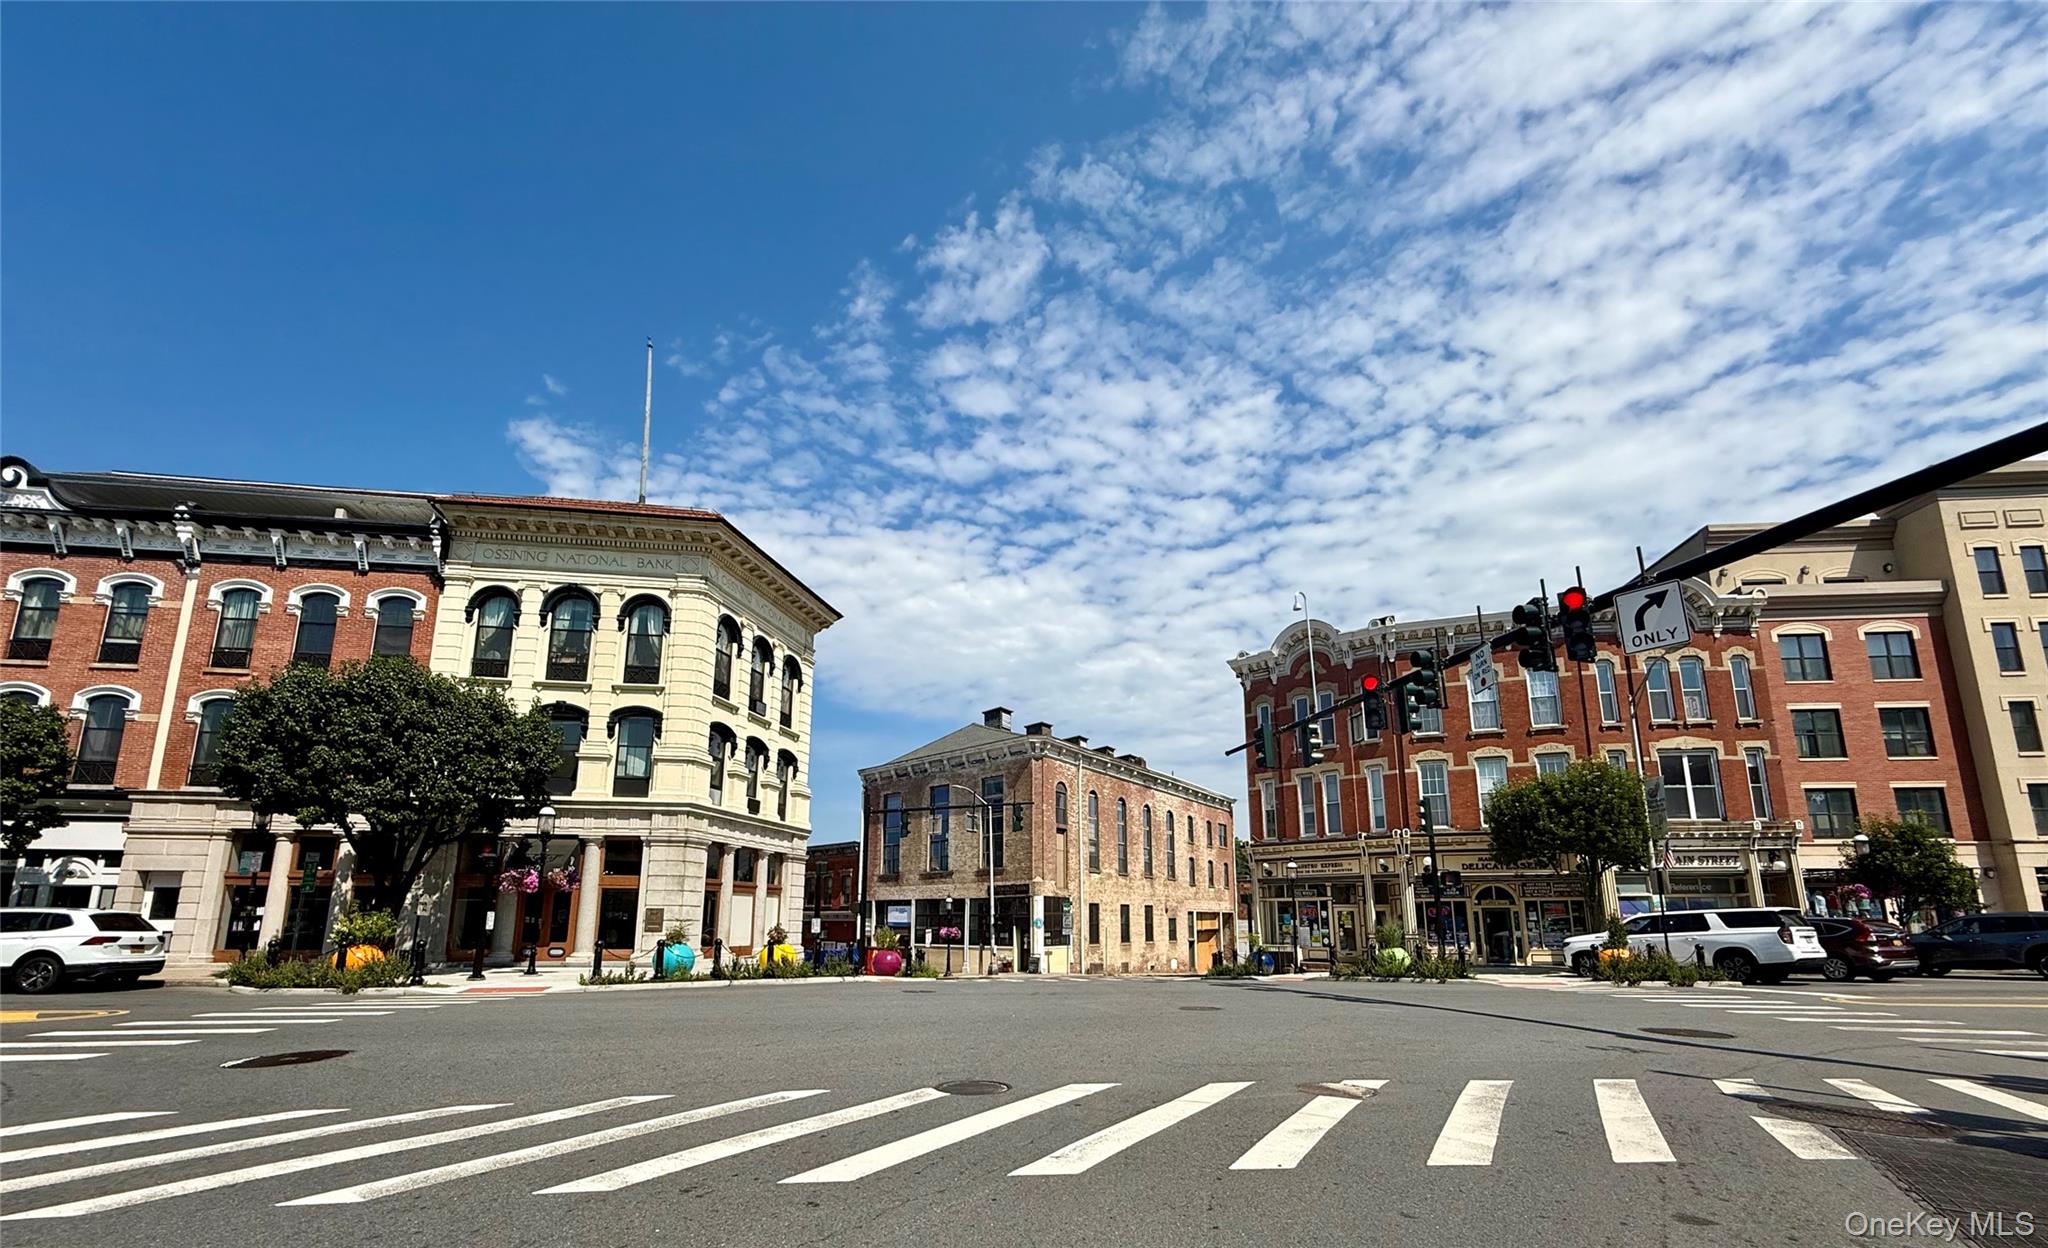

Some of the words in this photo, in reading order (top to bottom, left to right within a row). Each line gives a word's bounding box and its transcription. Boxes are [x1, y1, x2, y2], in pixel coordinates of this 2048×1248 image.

[482, 548, 548, 563] OSSINING
[555, 552, 627, 567] NATIONAL
[637, 557, 673, 570] BANK
[1632, 626, 1678, 647] ONLY
[1475, 649, 1485, 661] NO
[1697, 855, 1740, 866] STREET
